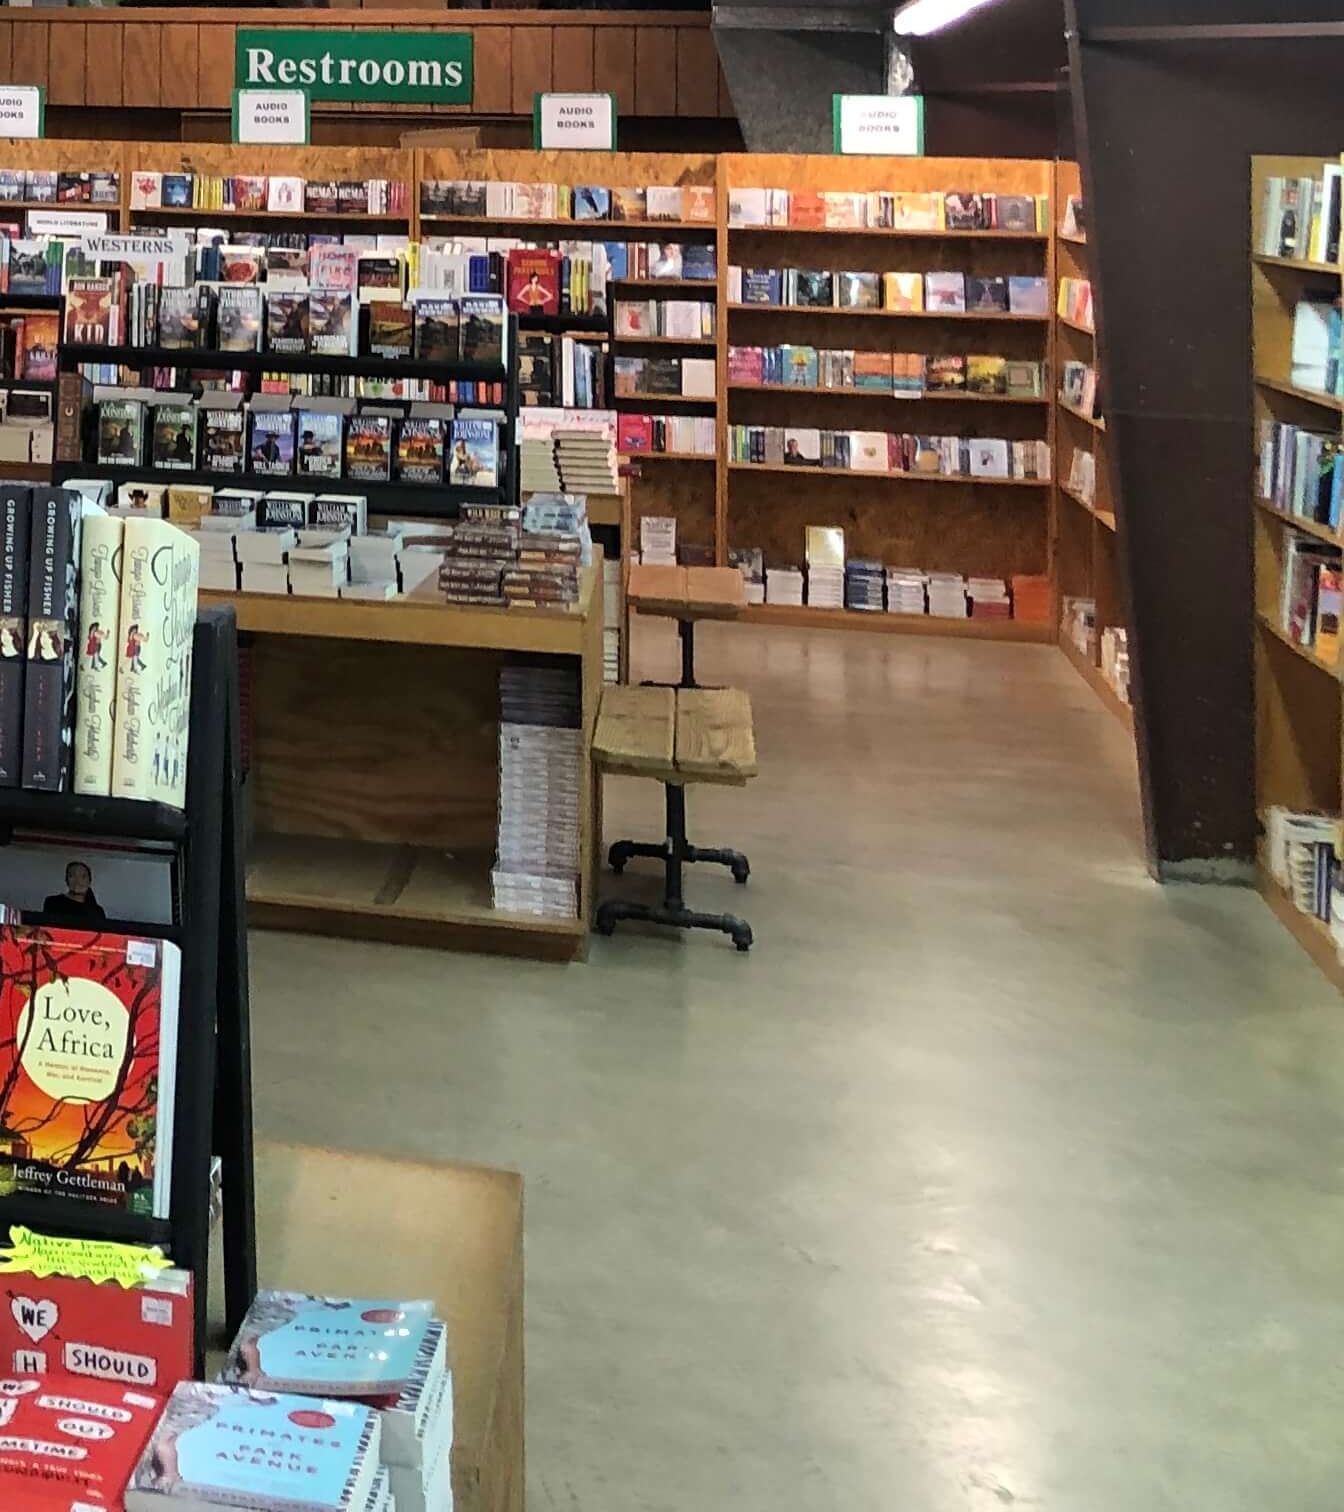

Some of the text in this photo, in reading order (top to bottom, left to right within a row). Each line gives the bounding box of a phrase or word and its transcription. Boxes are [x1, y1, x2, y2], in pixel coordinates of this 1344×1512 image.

[245, 46, 464, 87] Restrooms
[253, 115, 290, 124] BOOKS
[255, 102, 288, 111] AUDIO
[559, 106, 593, 116] AUDIO
[556, 120, 595, 129] BOOKS
[87, 236, 174, 254] WESTERNS
[2, 498, 16, 614] GROWING UP FISHER
[41, 500, 55, 615] GROWING UP FISHER
[43, 995, 111, 1031] Love,
[36, 1026, 114, 1060] Africa
[11, 1164, 127, 1193] Jeffrey Gettleman
[19, 1306, 48, 1327] WE
[71, 1348, 152, 1380] SHOULD
[44, 1395, 125, 1421] SHOULD
